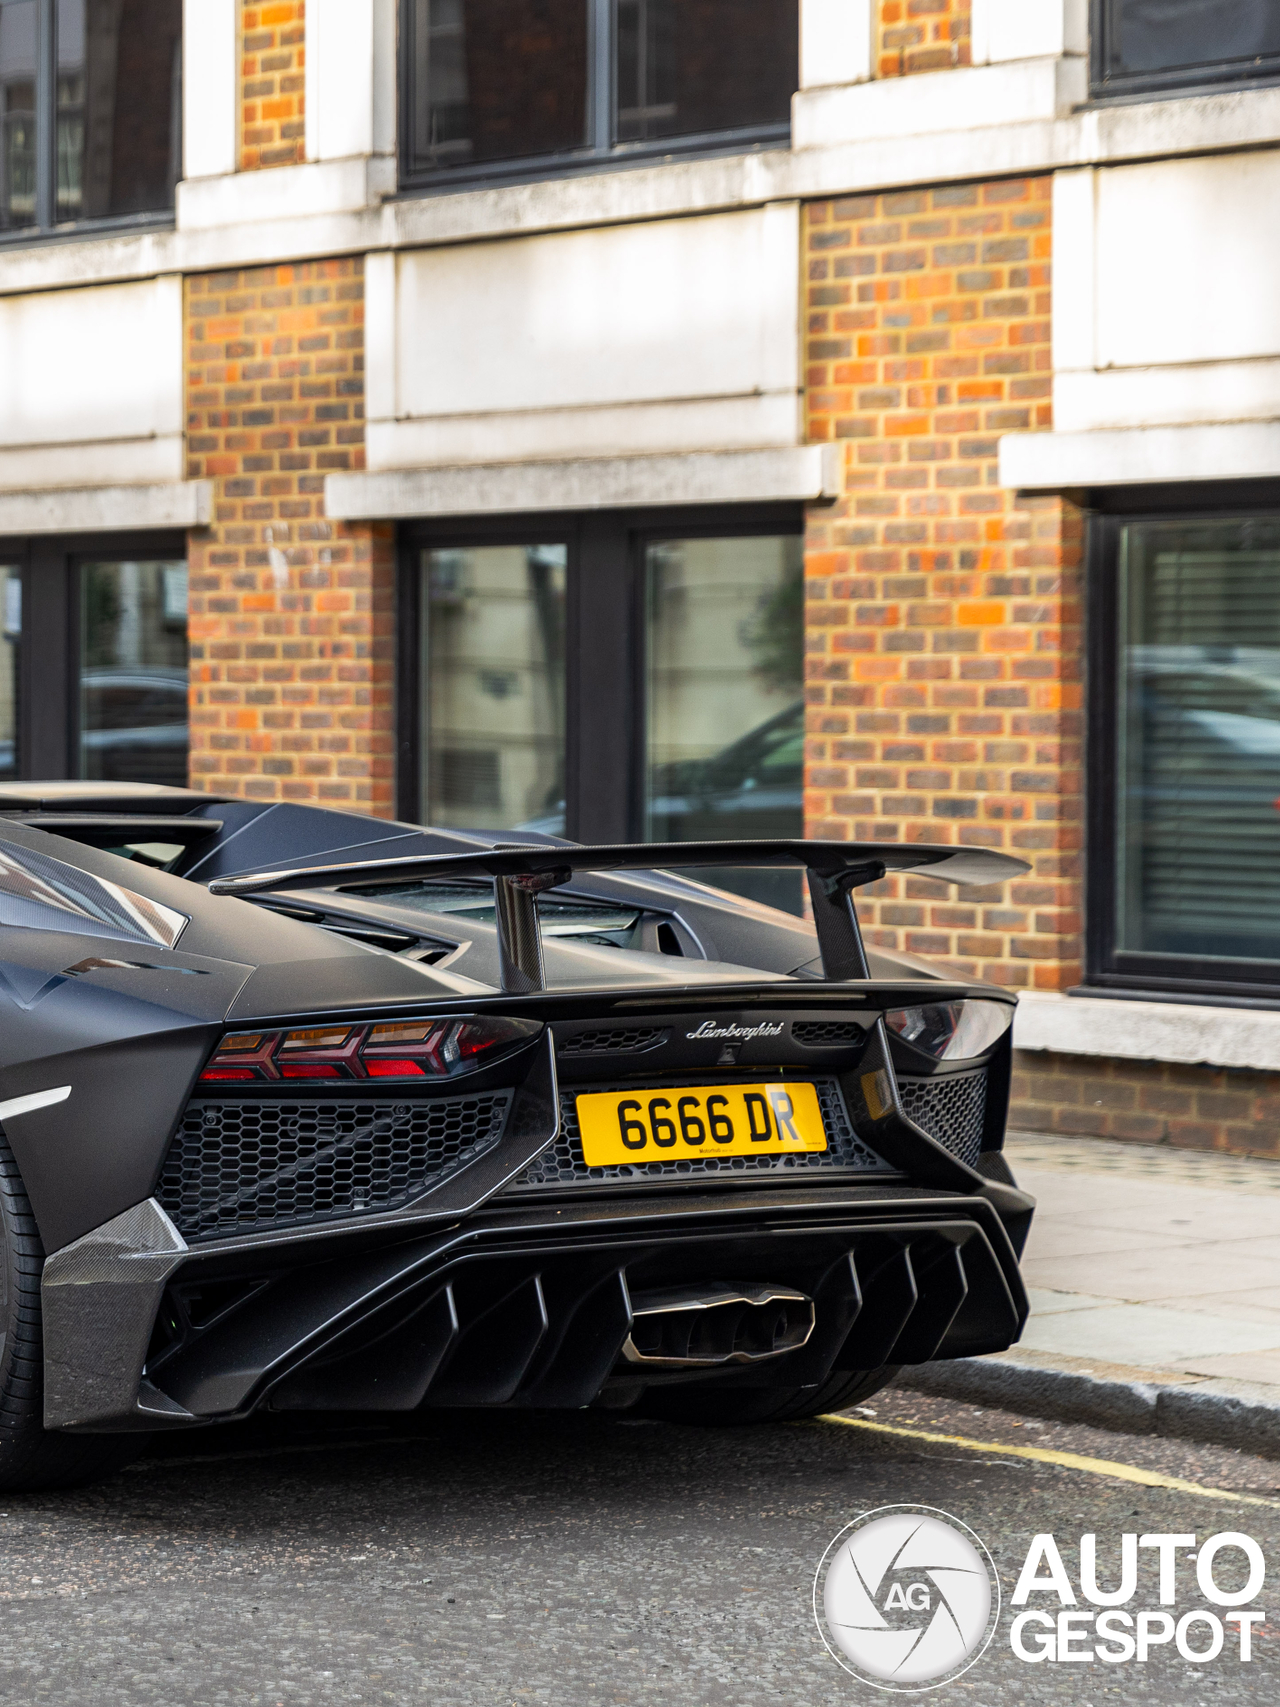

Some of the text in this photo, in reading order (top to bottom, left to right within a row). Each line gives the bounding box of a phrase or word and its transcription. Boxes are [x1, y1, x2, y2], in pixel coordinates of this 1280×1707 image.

[686, 1020, 785, 1040] Lamborghini
[617, 1091, 798, 1150] 6666 DR
